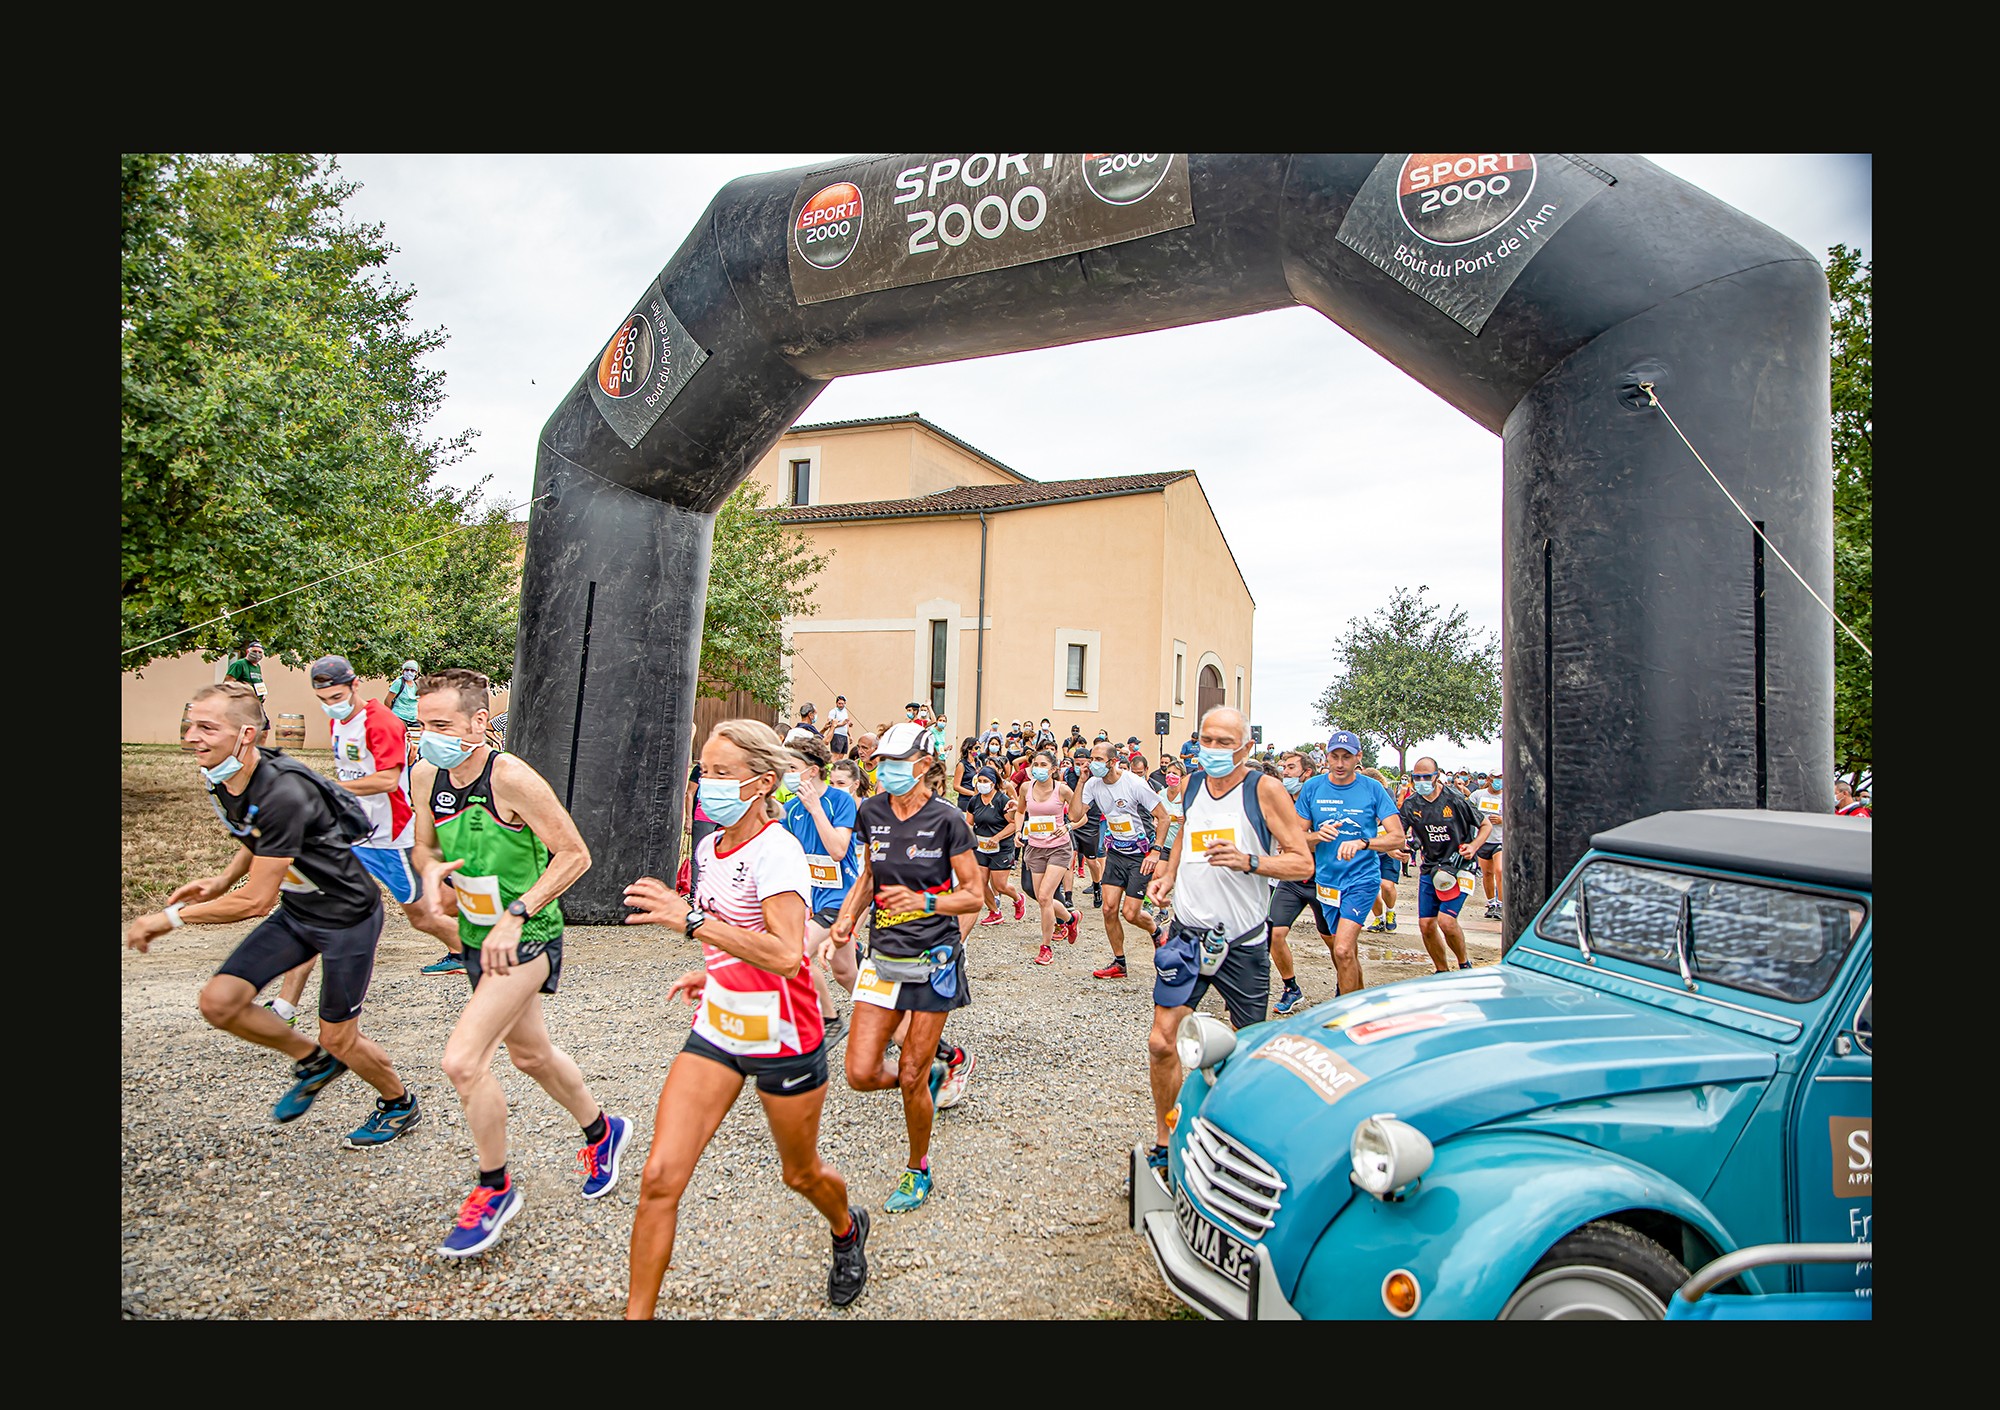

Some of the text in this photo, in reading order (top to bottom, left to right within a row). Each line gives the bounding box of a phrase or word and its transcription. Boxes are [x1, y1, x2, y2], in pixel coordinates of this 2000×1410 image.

[1409, 154, 1520, 190] SPORT
[1420, 175, 1511, 214] 2000
[802, 201, 858, 228] SPORT
[907, 185, 1048, 255] 2000
[806, 220, 851, 245] 2000
[1393, 202, 1557, 278] Bout du Pont de l'Arn
[657, 318, 669, 335] de
[608, 324, 632, 389] SPORT
[621, 327, 639, 383] 2000
[660, 335, 672, 365] Pont
[658, 367, 670, 383] du
[644, 381, 667, 408] Bout
[1424, 824, 1448, 833] Uber
[1428, 832, 1450, 842] Eats
[720, 1013, 745, 1036] 540
[1847, 1130, 1872, 1170] S
[1194, 1217, 1220, 1266] MA
[1224, 1236, 1250, 1287] 32
